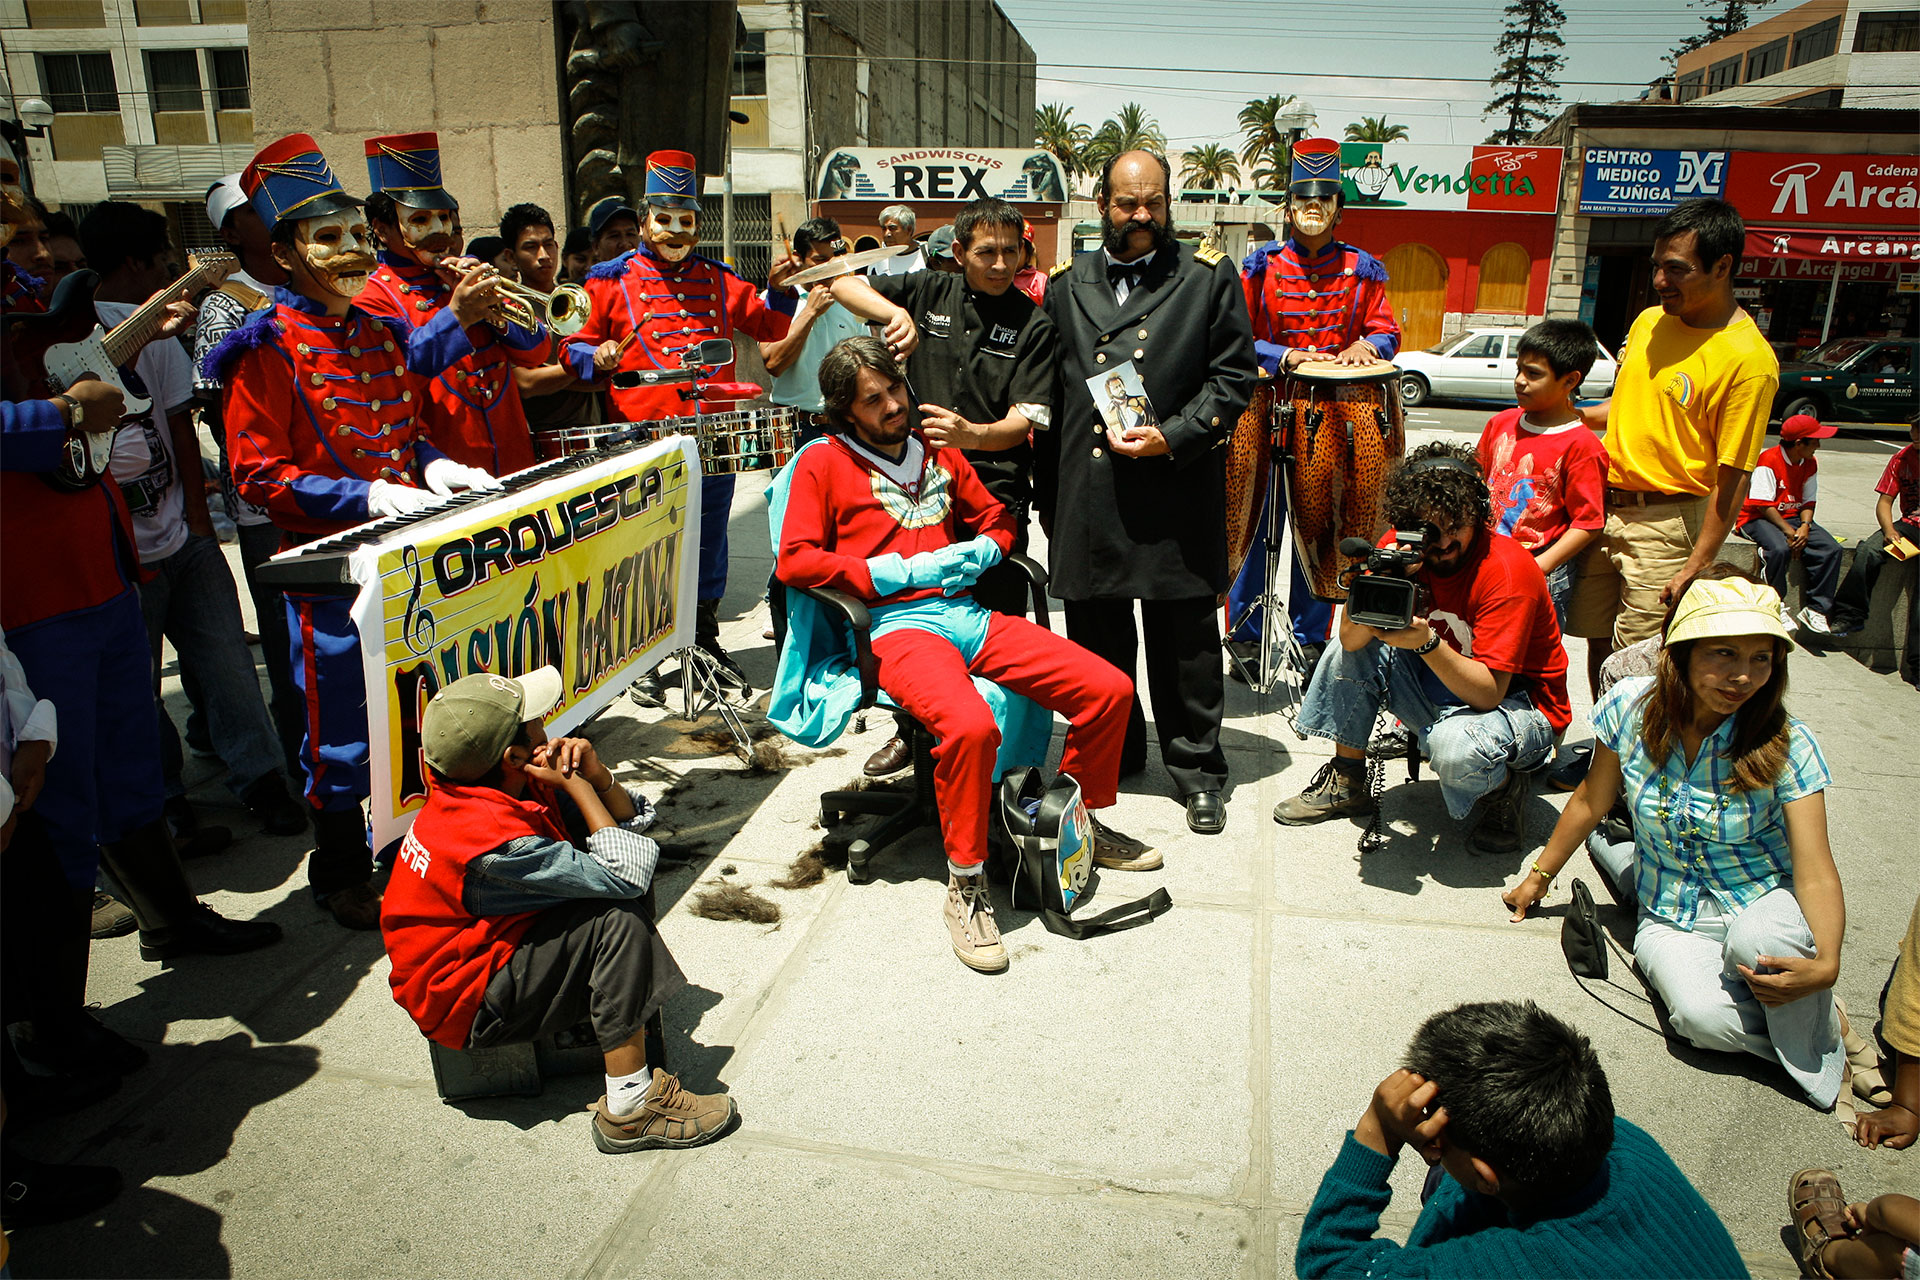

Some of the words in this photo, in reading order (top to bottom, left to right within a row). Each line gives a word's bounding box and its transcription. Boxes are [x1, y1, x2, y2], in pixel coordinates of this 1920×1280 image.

[876, 150, 1004, 169] SANDWISCHS
[1585, 150, 1653, 166] CENTRO
[1393, 162, 1536, 197] Vendetta
[1597, 167, 1661, 183] MEDICO
[1866, 163, 1919, 177] Cadena
[890, 166, 991, 199] REX
[1608, 184, 1672, 201] ZUÑIGA
[1824, 170, 1919, 209] Arcá
[1579, 204, 1592, 212] SAN
[1592, 205, 1617, 213] MARTIN
[989, 322, 1017, 345] LIFE
[432, 467, 664, 599] ORQUESTA
[573, 530, 679, 699] LATINA
